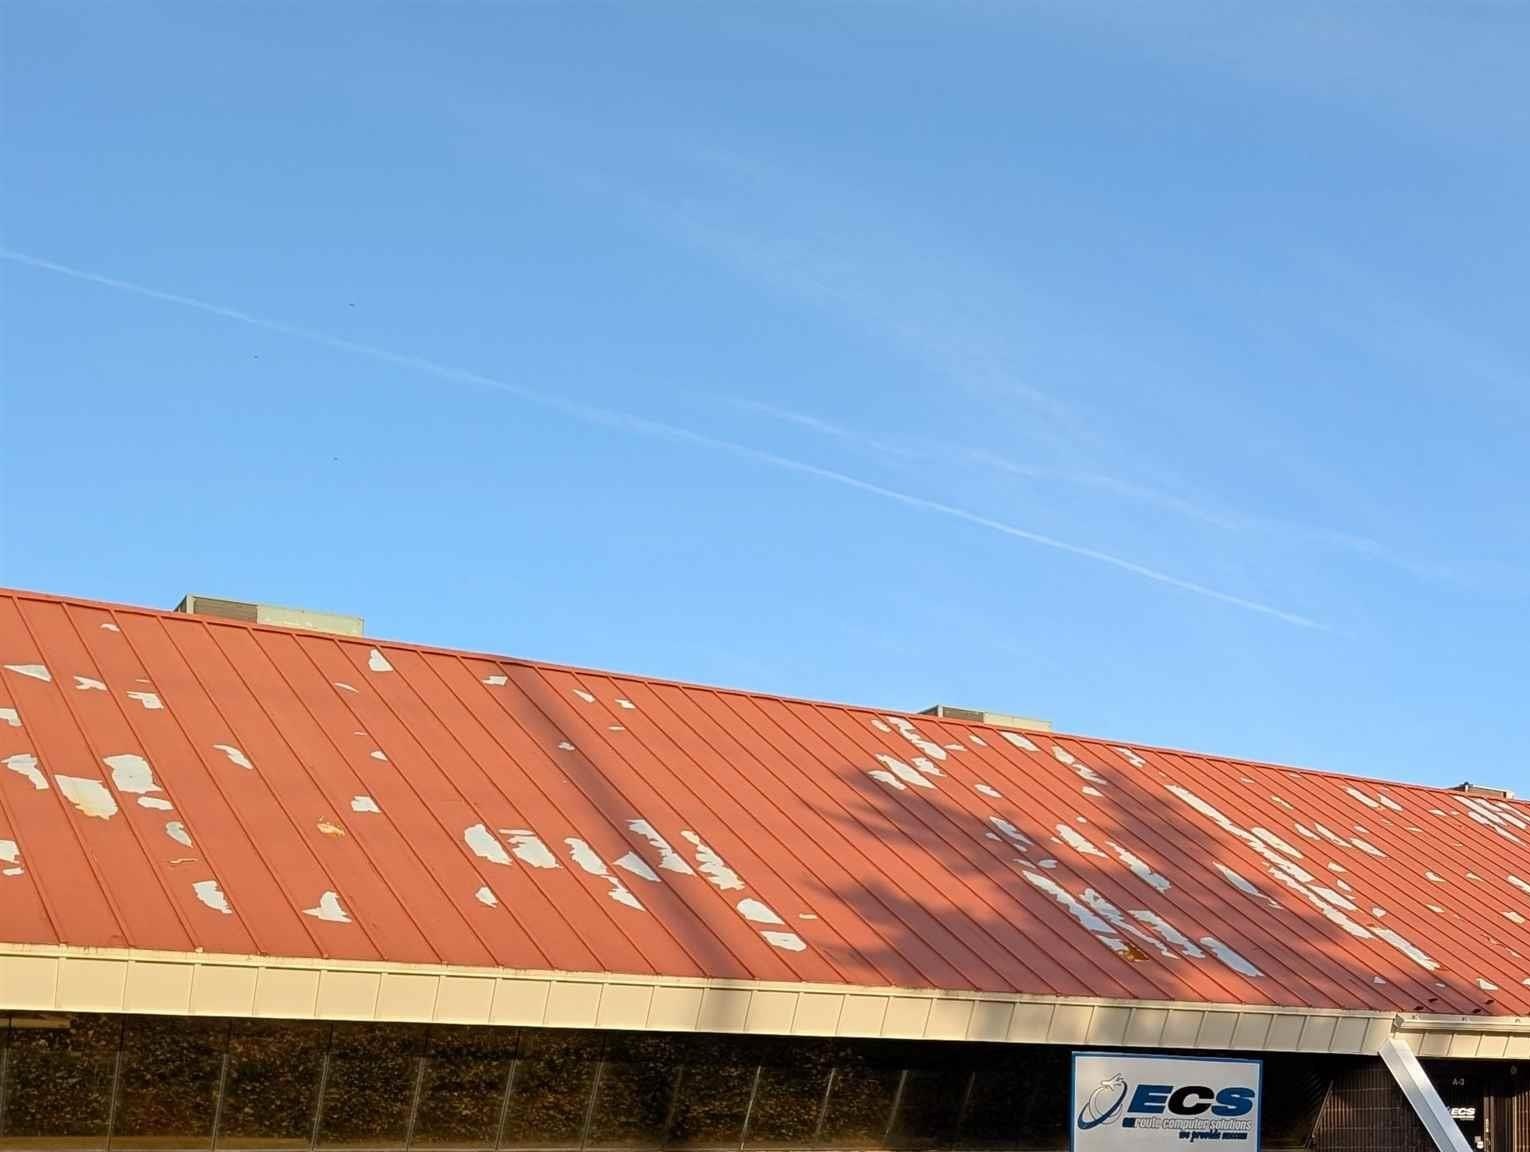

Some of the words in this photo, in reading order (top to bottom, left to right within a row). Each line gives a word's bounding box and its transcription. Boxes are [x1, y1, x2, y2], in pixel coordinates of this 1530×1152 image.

[1127, 1084, 1256, 1117] ECS
[1451, 1107, 1476, 1115] ECS
[1209, 1119, 1252, 1130] solutions
